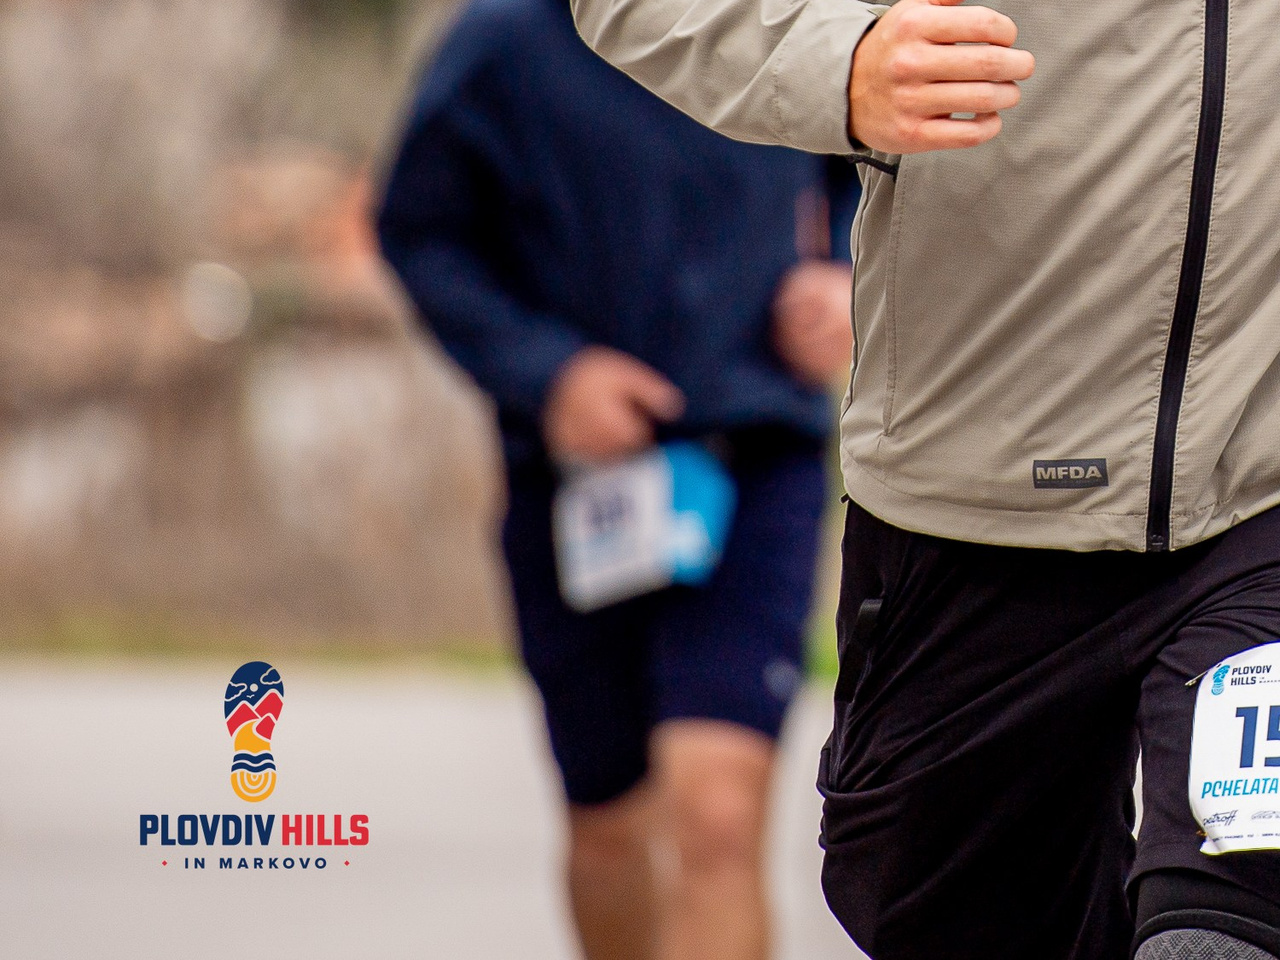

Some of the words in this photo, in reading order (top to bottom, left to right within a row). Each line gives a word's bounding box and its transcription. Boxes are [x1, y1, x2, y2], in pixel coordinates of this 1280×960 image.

[1035, 465, 1103, 480] MFDA
[1231, 664, 1272, 676] PLOVDIV
[1230, 676, 1257, 686] HILLS
[1201, 777, 1279, 800] PCHELATA
